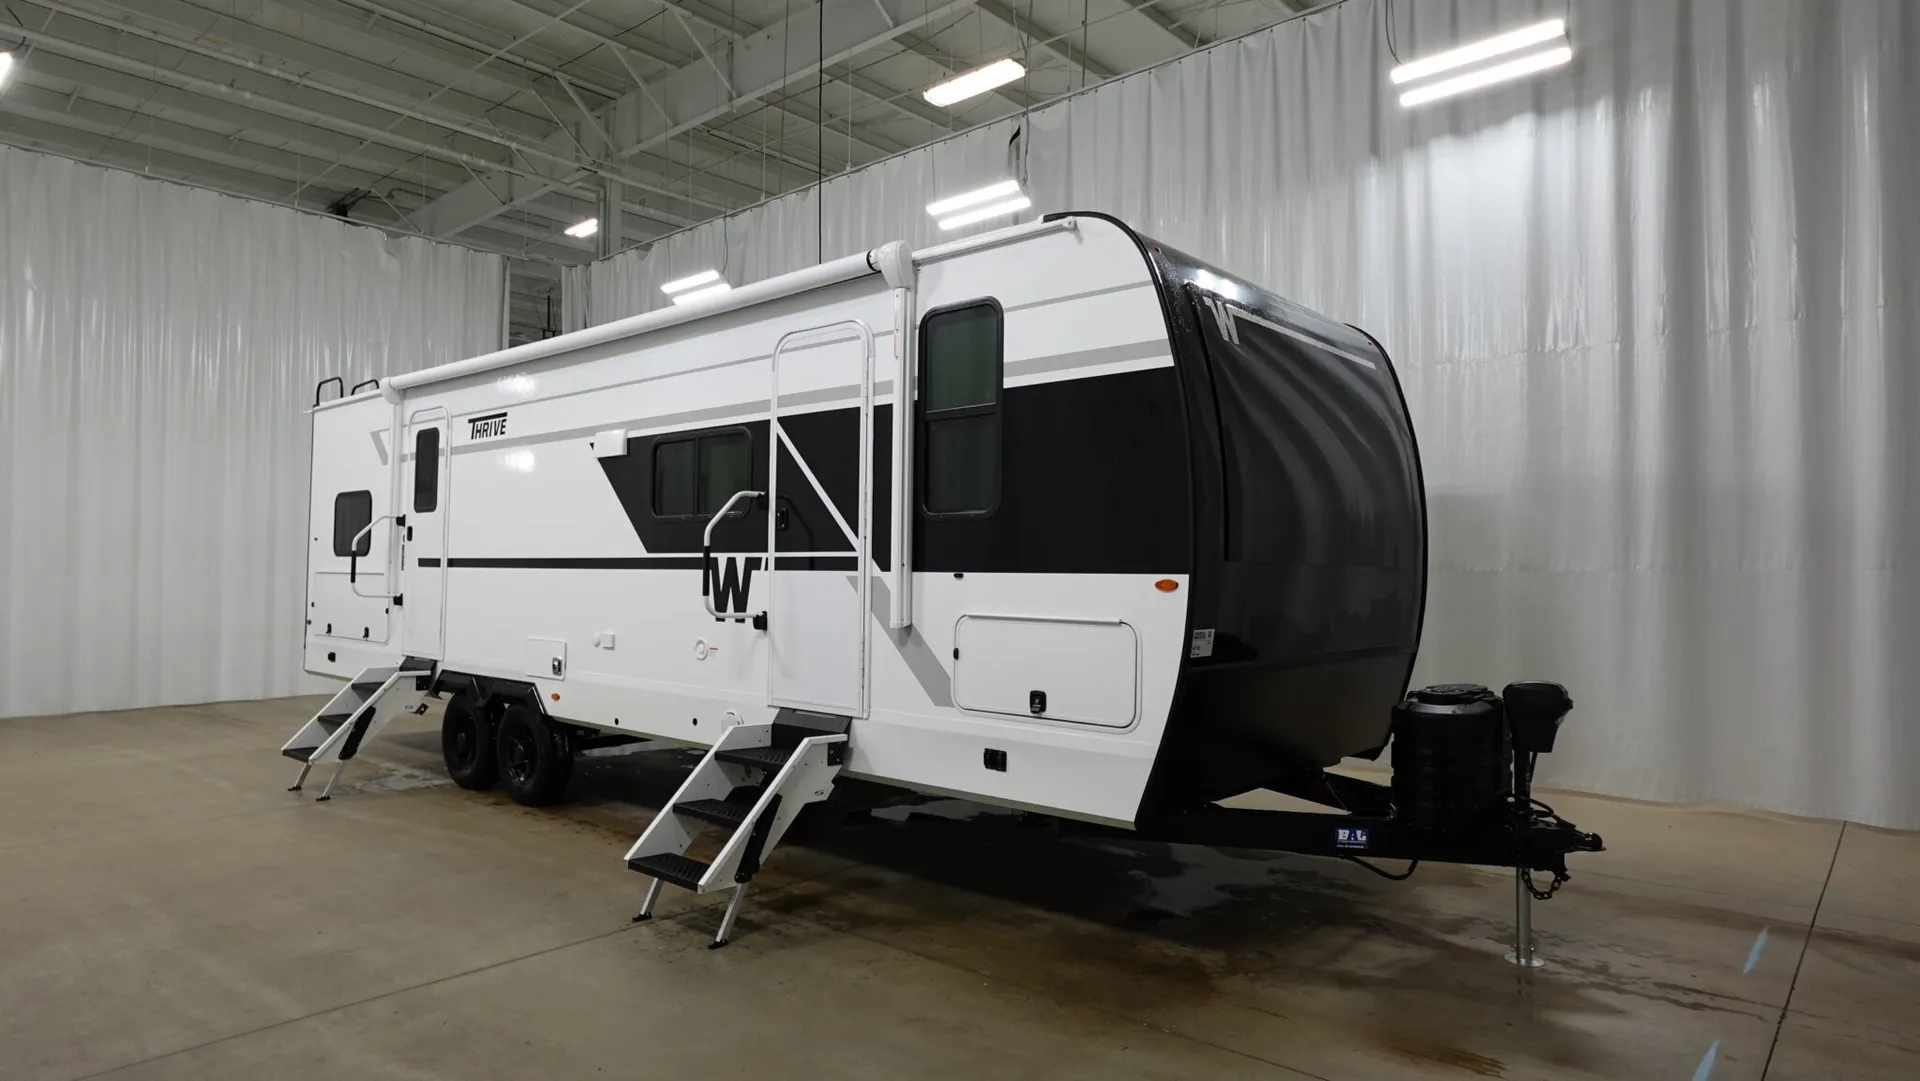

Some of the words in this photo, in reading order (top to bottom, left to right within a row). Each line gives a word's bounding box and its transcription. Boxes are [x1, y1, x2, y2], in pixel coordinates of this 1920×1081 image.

[1203, 296, 1240, 345] W
[468, 411, 508, 440] THRIVE
[706, 556, 762, 623] W
